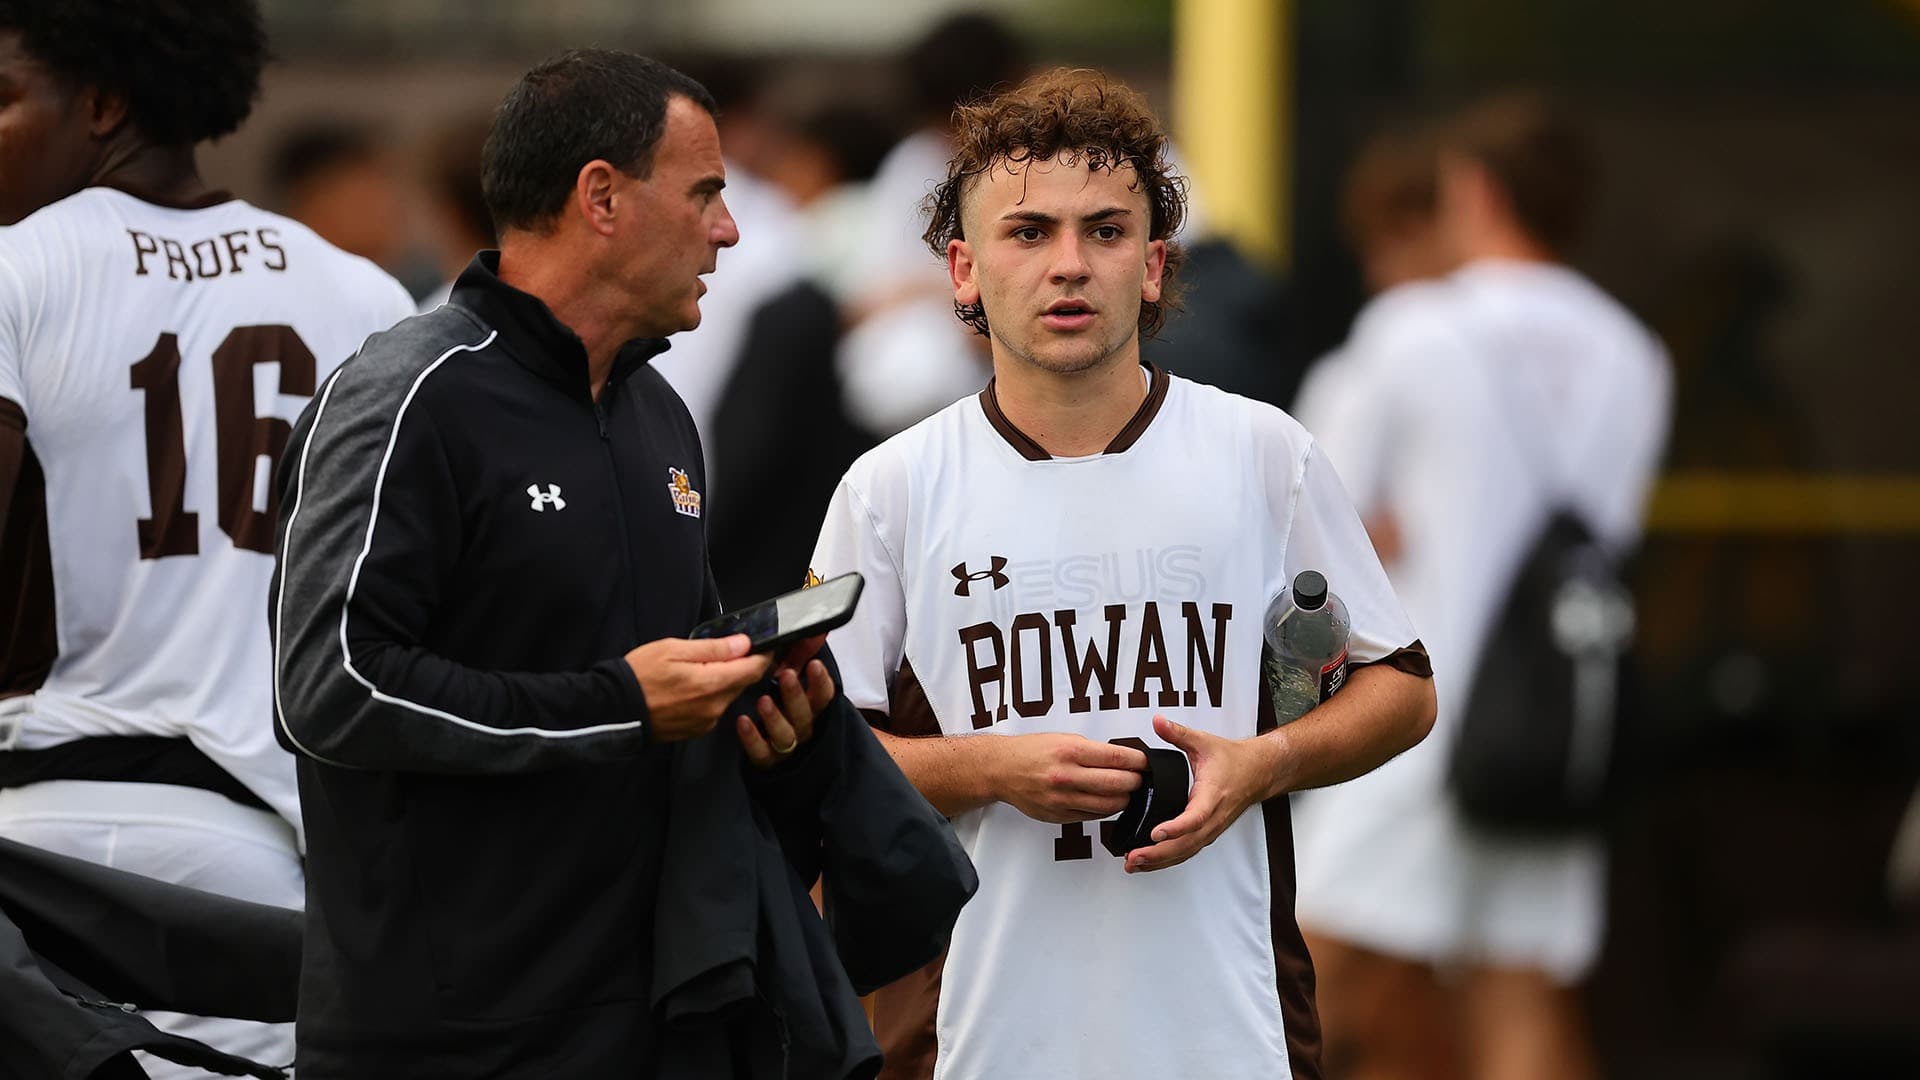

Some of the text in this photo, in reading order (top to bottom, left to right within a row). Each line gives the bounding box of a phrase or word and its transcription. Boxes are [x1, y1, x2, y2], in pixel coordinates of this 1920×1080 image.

[127, 229, 287, 282] PROFS
[130, 324, 316, 560] 16
[958, 601, 1233, 730] ROWAN
